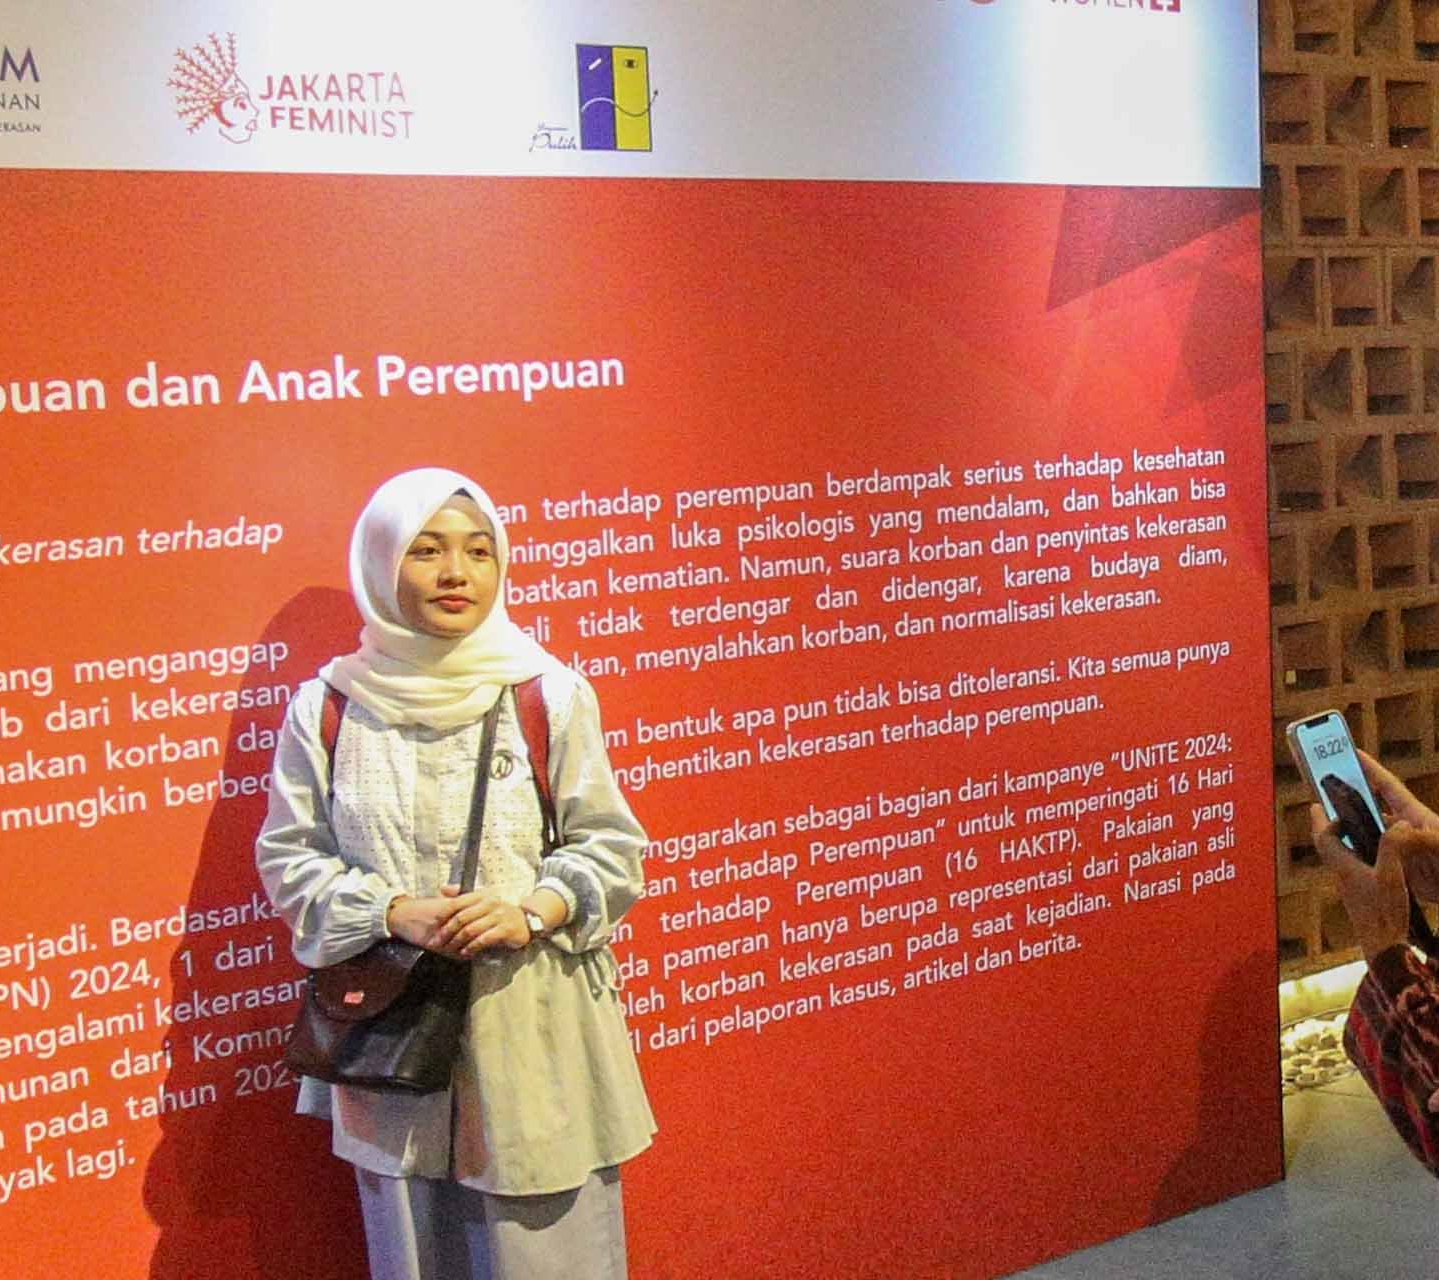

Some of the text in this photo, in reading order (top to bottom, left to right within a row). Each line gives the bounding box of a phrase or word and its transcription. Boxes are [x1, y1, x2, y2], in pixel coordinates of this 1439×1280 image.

[259, 71, 406, 103] JAKARTA
[270, 106, 413, 140] FEMINIST
[124, 360, 221, 408] dan
[237, 353, 363, 404] Anak
[376, 353, 625, 402] Perempuan
[136, 515, 284, 555] terhadap
[671, 478, 1226, 551] luka psikologis yang mendalam, dan bahkan bisa
[72, 641, 289, 684] menganggap
[650, 933, 1082, 1049] dari pelaporan kasus, artikel dan berita.
[65, 1138, 135, 1180] lagi.
